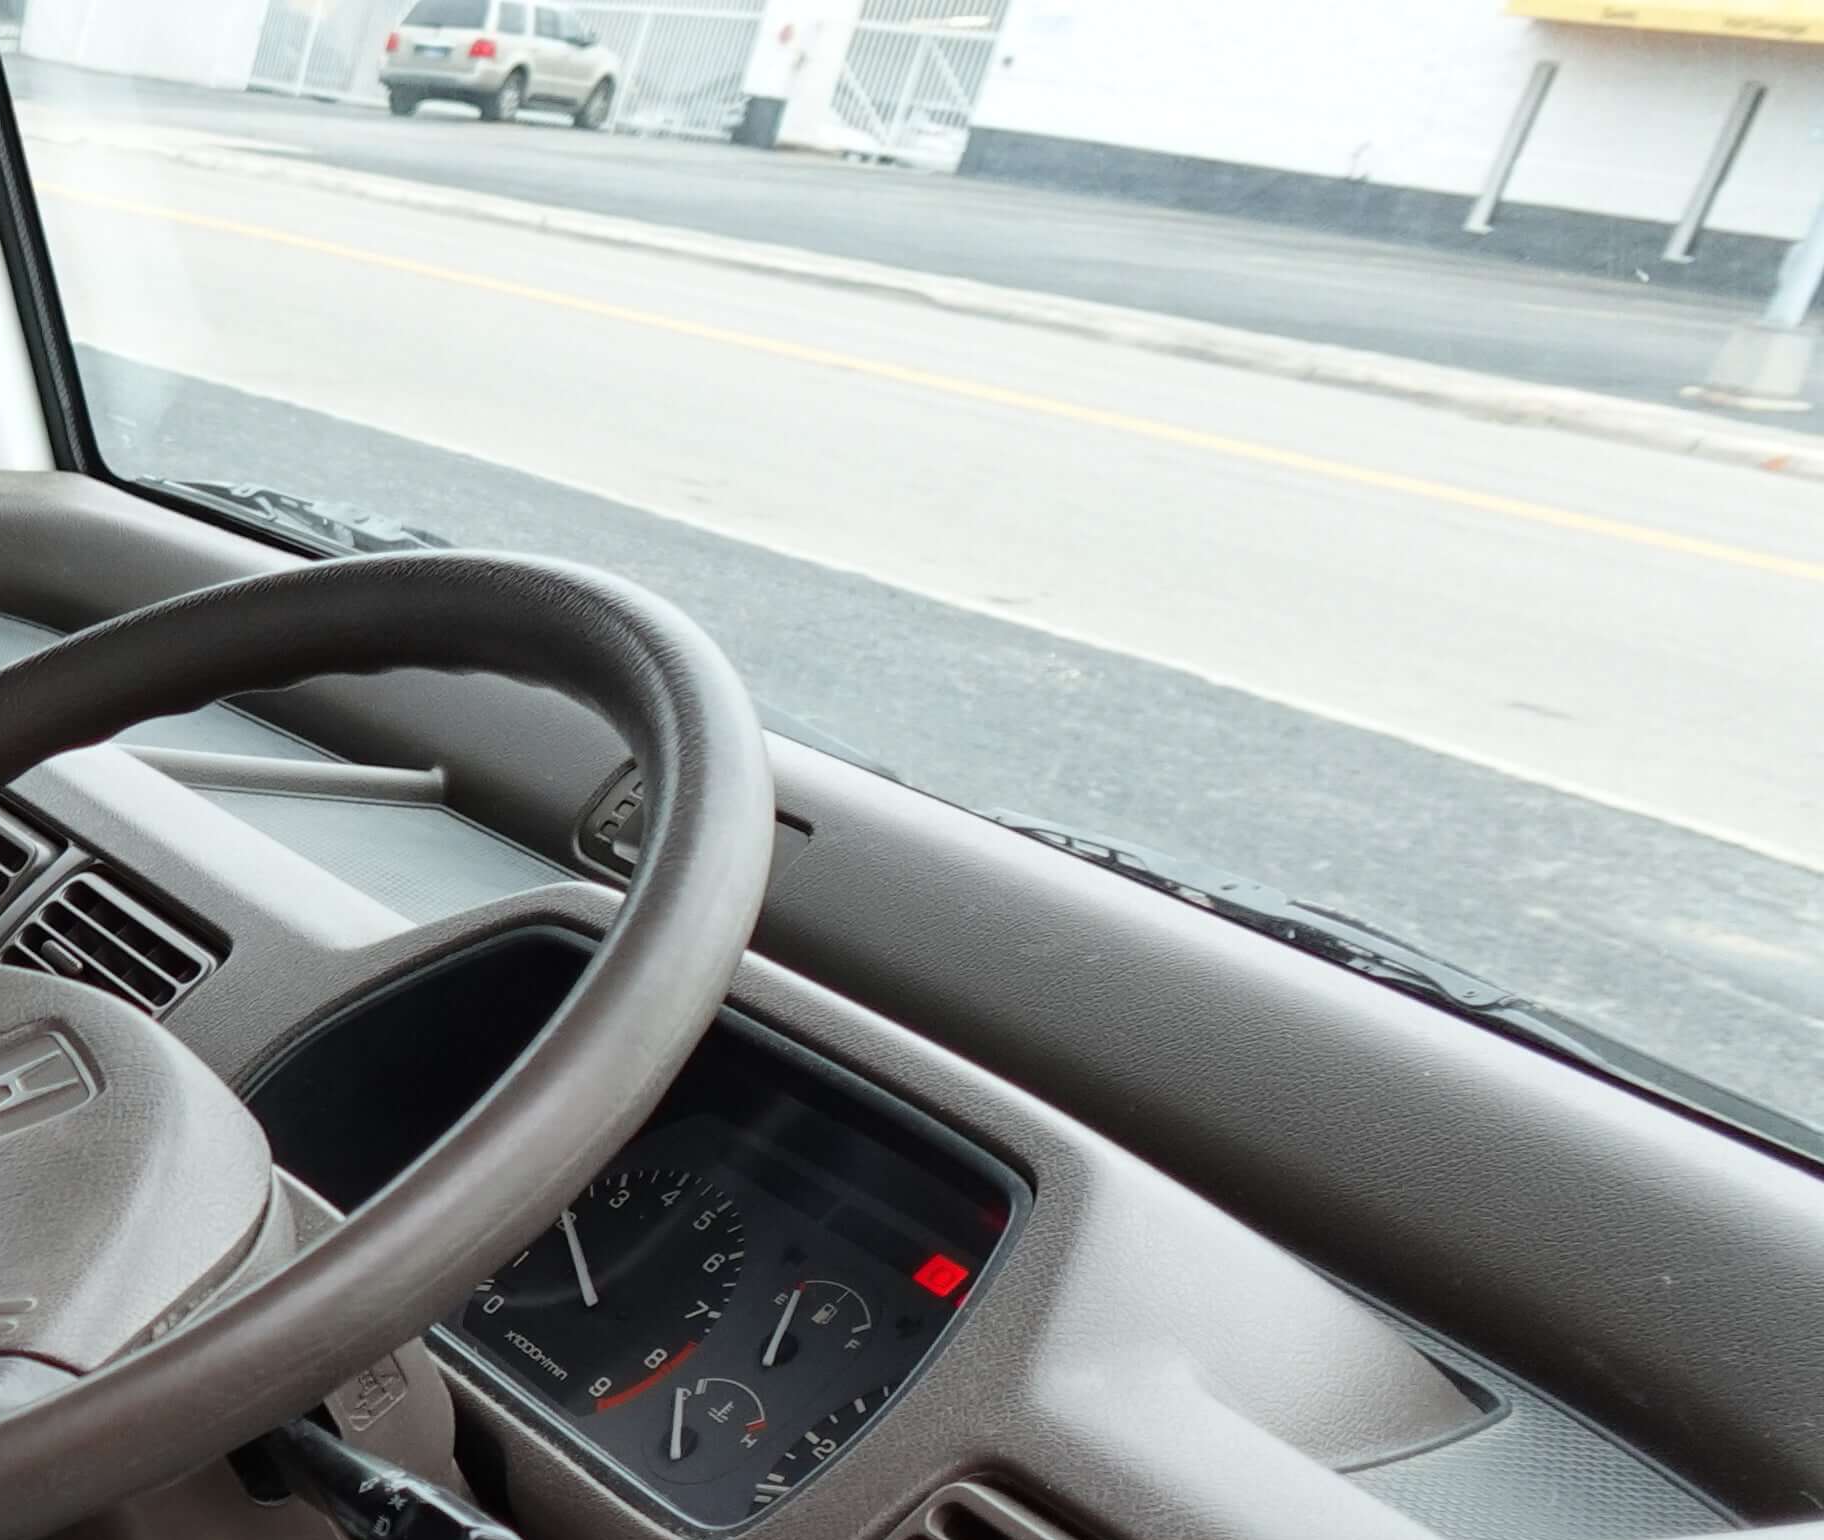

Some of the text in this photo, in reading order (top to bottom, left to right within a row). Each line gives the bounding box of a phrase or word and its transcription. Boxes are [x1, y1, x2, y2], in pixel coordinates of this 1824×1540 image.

[609, 1189, 630, 1208] 3
[661, 1190, 681, 1206] 4
[692, 1211, 718, 1231] 5
[703, 1253, 726, 1274] 6
[483, 1296, 505, 1315] 0
[774, 1293, 789, 1306] E
[684, 1301, 709, 1319] 7
[843, 1339, 862, 1351] F
[644, 1348, 668, 1370] 8
[588, 1377, 613, 1399] 9
[739, 1436, 759, 1449] H
